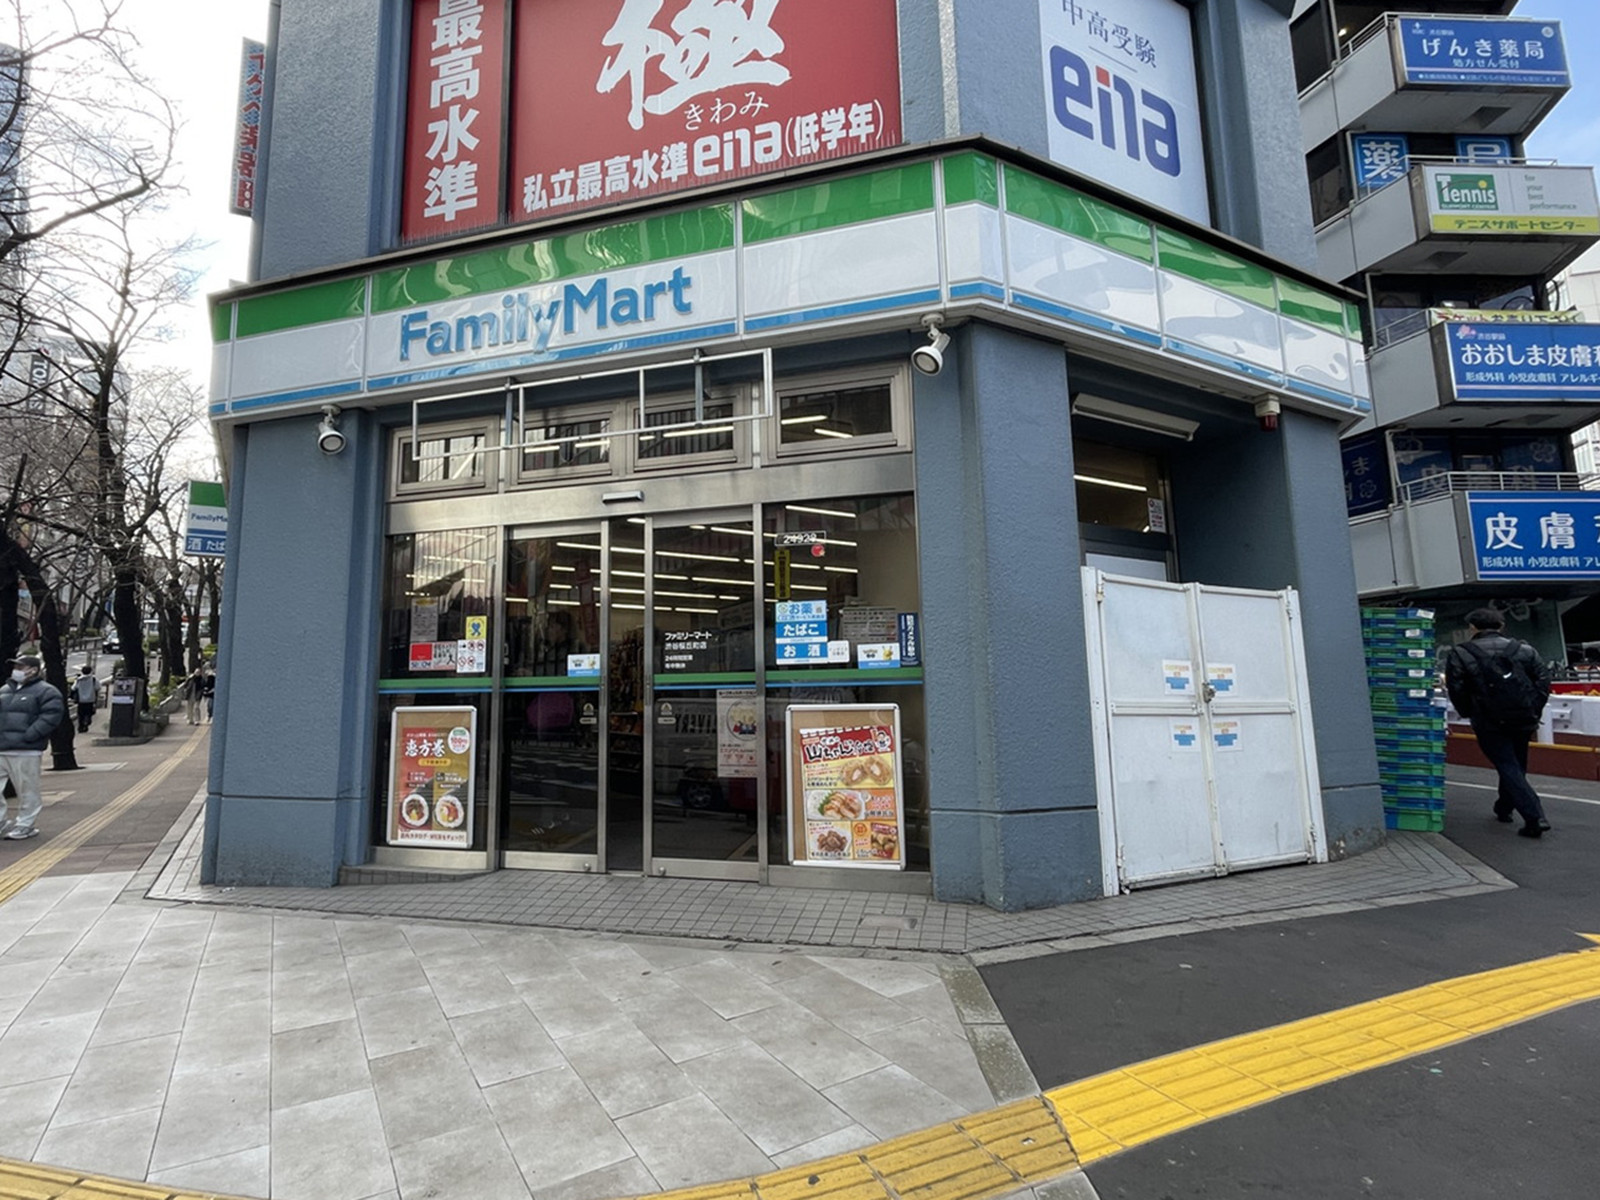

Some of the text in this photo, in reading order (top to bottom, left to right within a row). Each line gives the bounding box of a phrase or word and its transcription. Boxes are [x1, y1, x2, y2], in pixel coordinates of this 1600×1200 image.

[1062, 0, 1158, 68] 中高受験
[1422, 37, 1545, 60] げんき薬局
[1452, 57, 1520, 69] 処方せん受付
[424, 0, 484, 222] 最高水準
[684, 91, 769, 131] きわみ
[1049, 44, 1181, 178] ena
[1436, 175, 1496, 203] Tennis
[1529, 203, 1577, 211] performance
[1455, 220, 1586, 230] テニスサポートセンター
[399, 265, 693, 362] FamilyMart
[1466, 372, 1504, 382] 形成外科
[1508, 372, 1556, 383] 小児皮膚科
[1485, 511, 1600, 549] 皮膚
[187, 538, 202, 550] 酒
[1482, 556, 1524, 567] 形成外科
[1528, 556, 1579, 567] 小児皮膚科
[789, 603, 812, 614] お薬
[665, 631, 712, 640] ファミリーマート
[783, 623, 819, 636] たばこ
[784, 644, 820, 657] お酒
[405, 738, 445, 757] 恵方巻
